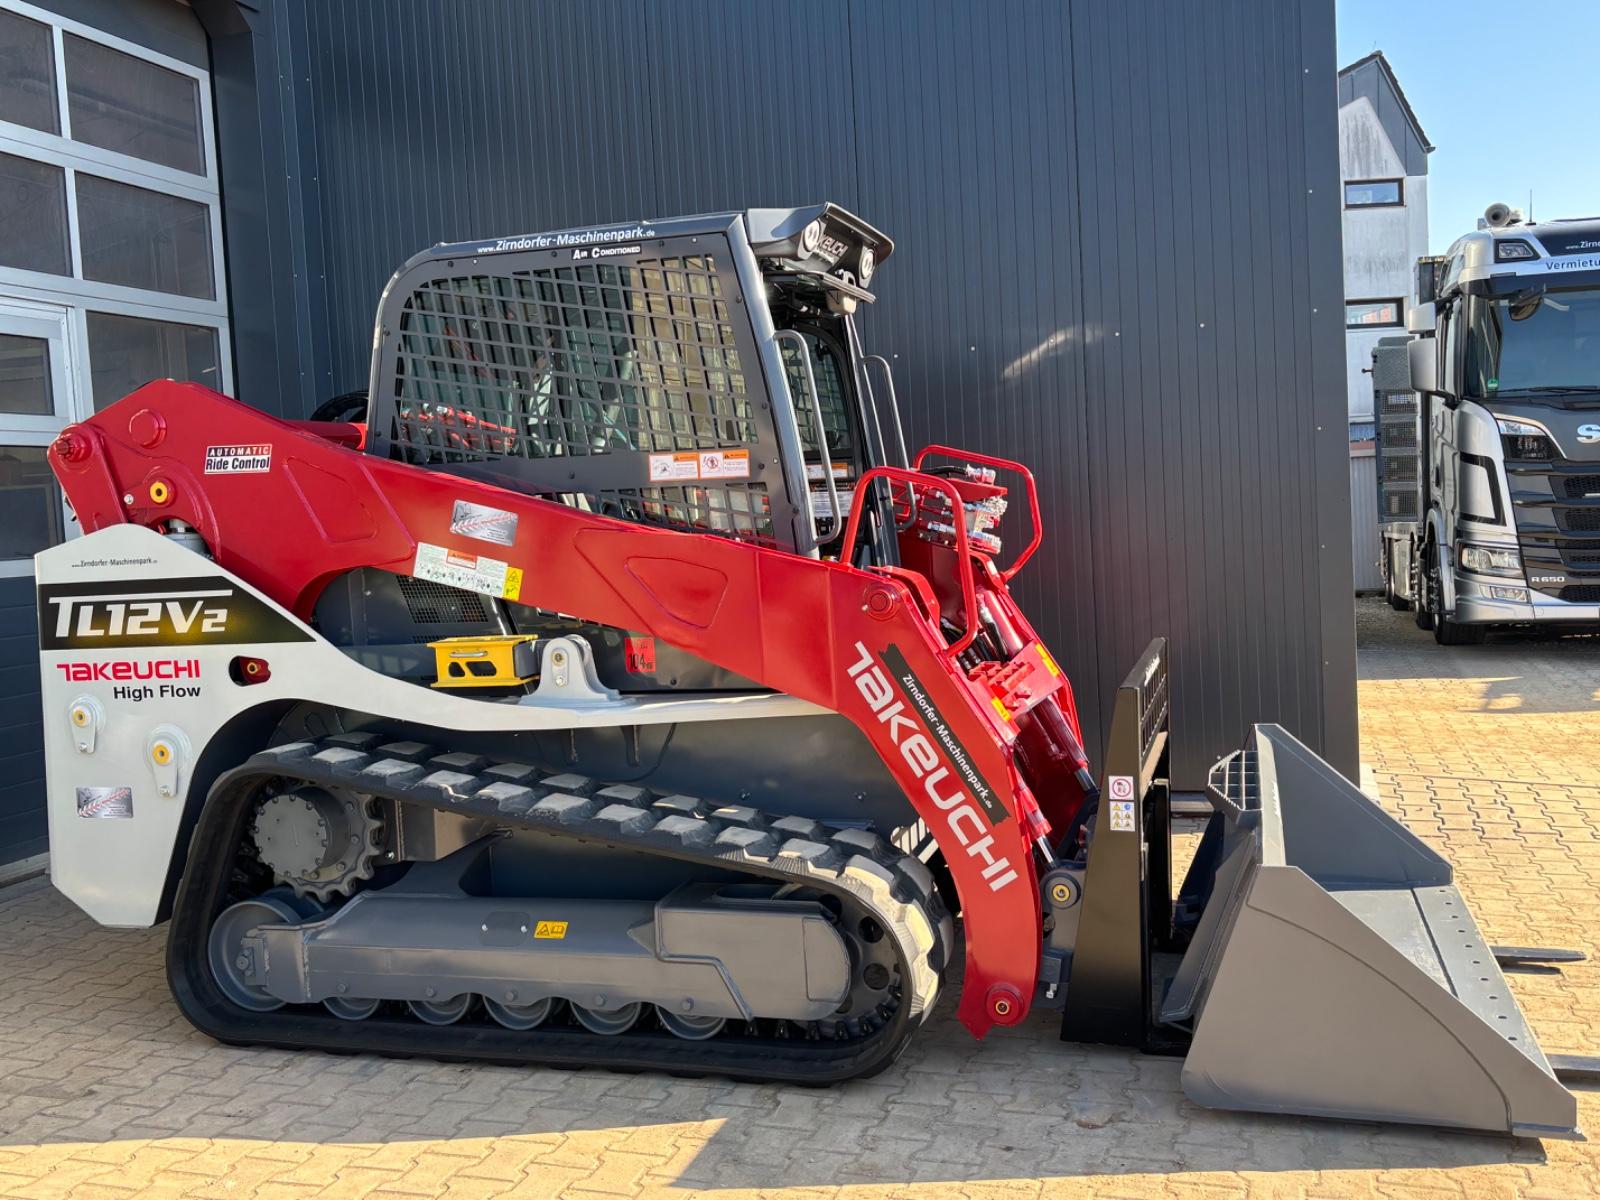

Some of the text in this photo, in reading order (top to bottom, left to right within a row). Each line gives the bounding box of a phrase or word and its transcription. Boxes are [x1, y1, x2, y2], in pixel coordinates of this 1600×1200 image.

[477, 227, 655, 254] www.Zirndorfer-Maschinenpark.de
[209, 446, 270, 457] AUTOMATIC
[205, 456, 270, 470] Ride Control
[113, 684, 201, 702] High Flow
[902, 673, 993, 809] Zirndorfer-Maschinenpark.de
